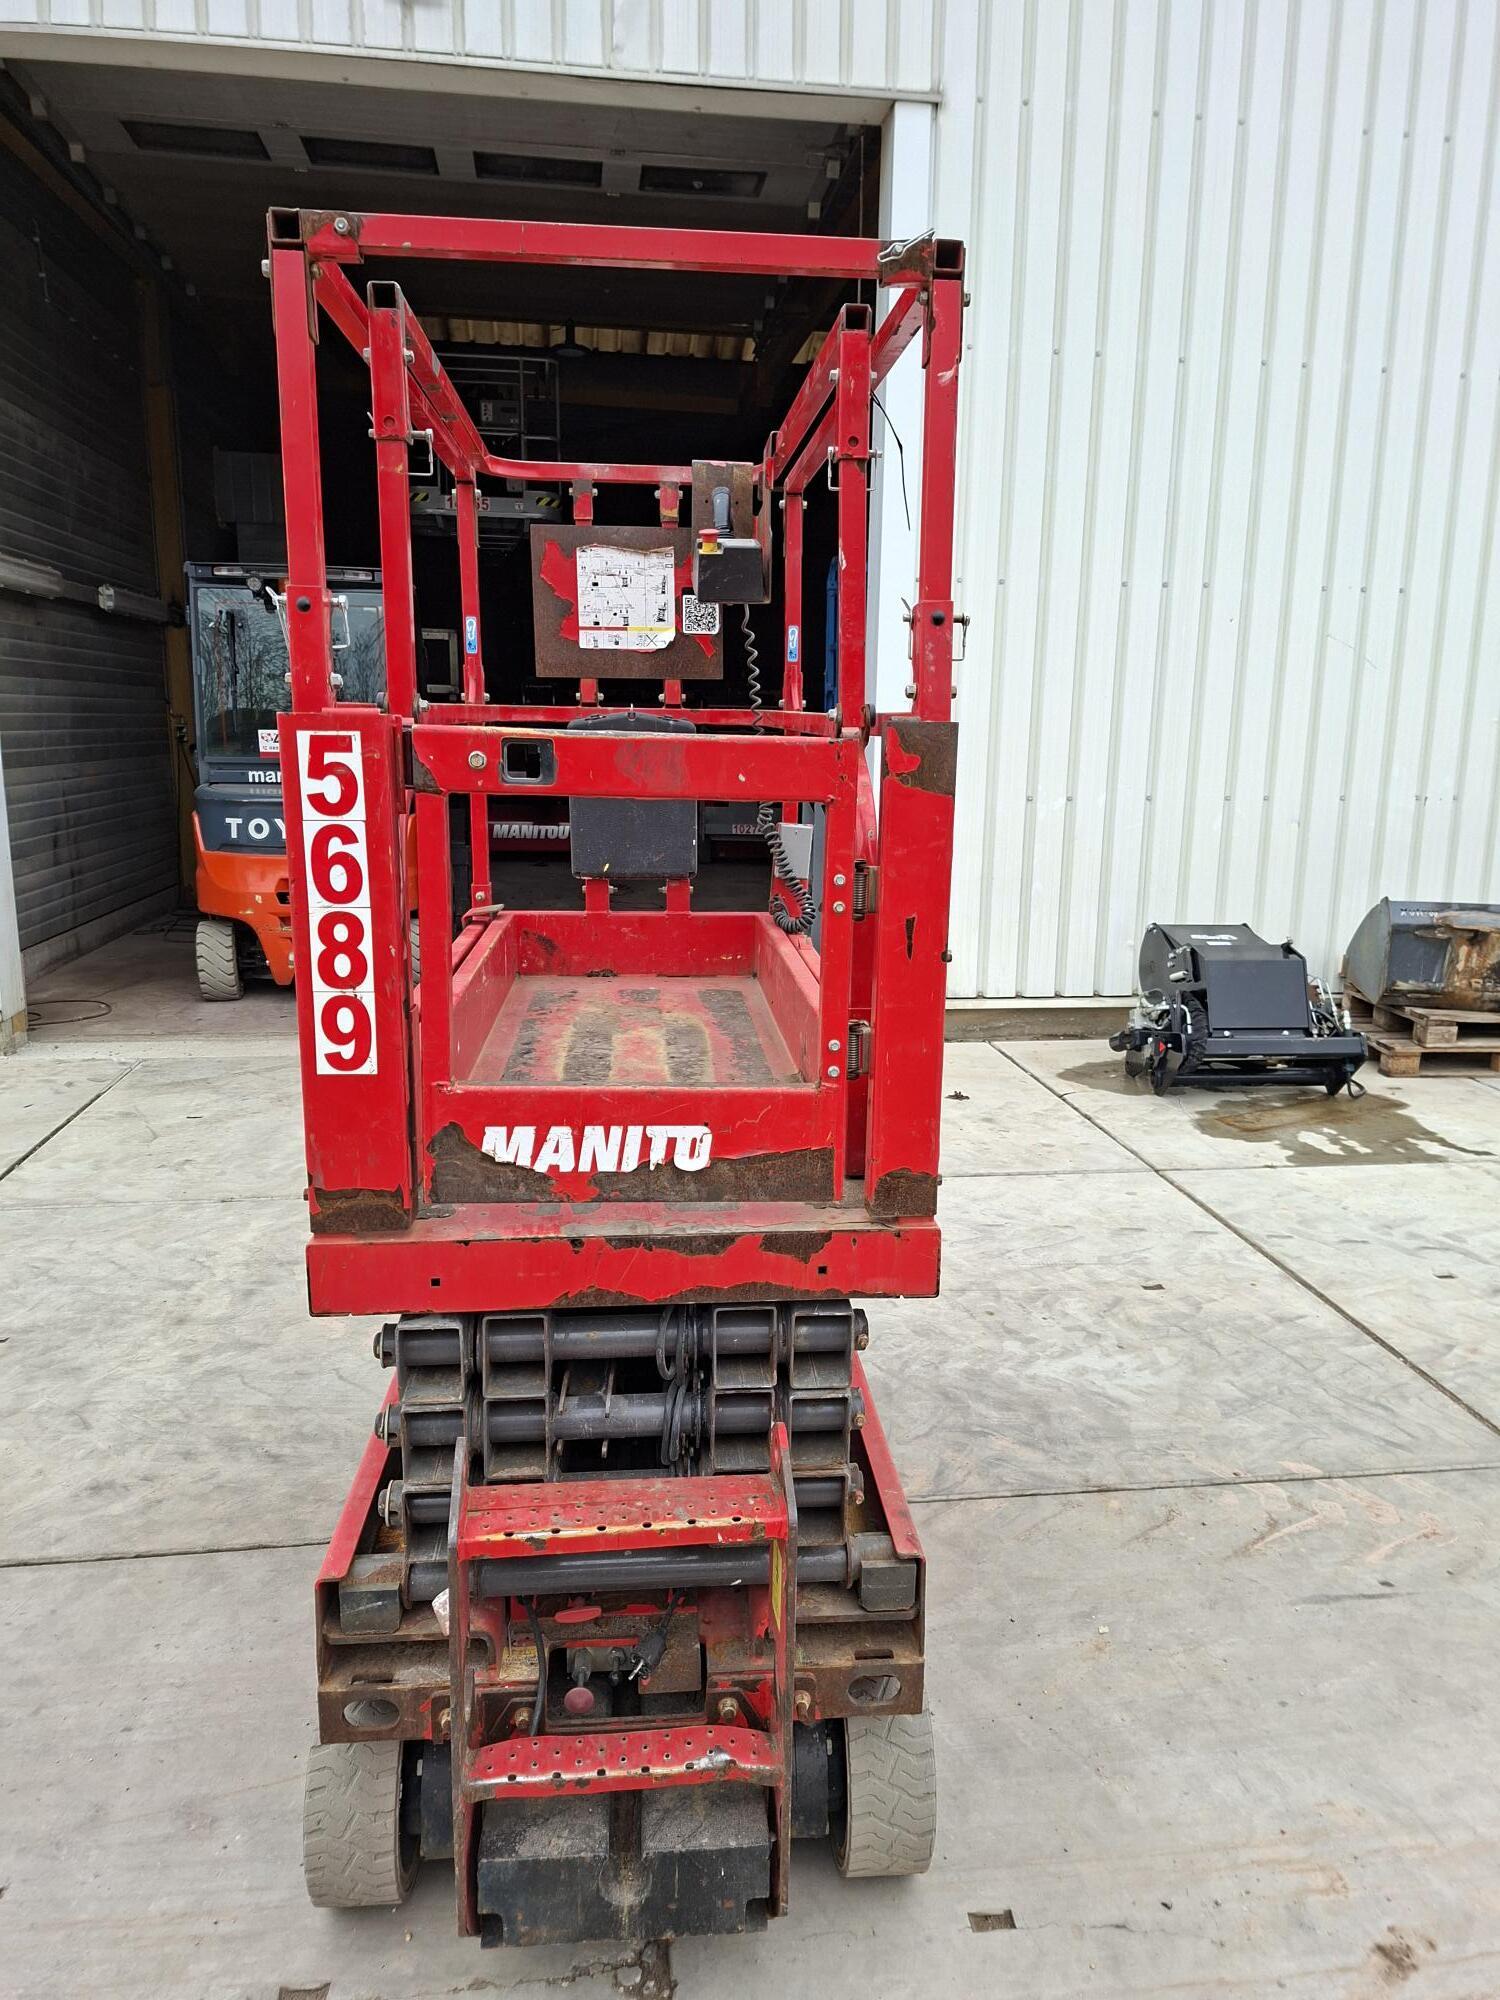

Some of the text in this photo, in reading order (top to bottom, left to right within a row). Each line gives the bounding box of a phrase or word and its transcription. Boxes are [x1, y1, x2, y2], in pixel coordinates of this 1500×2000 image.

[492, 824, 570, 839] MANITOU
[306, 734, 372, 1072] 5689
[481, 1125, 712, 1173] MANITO
